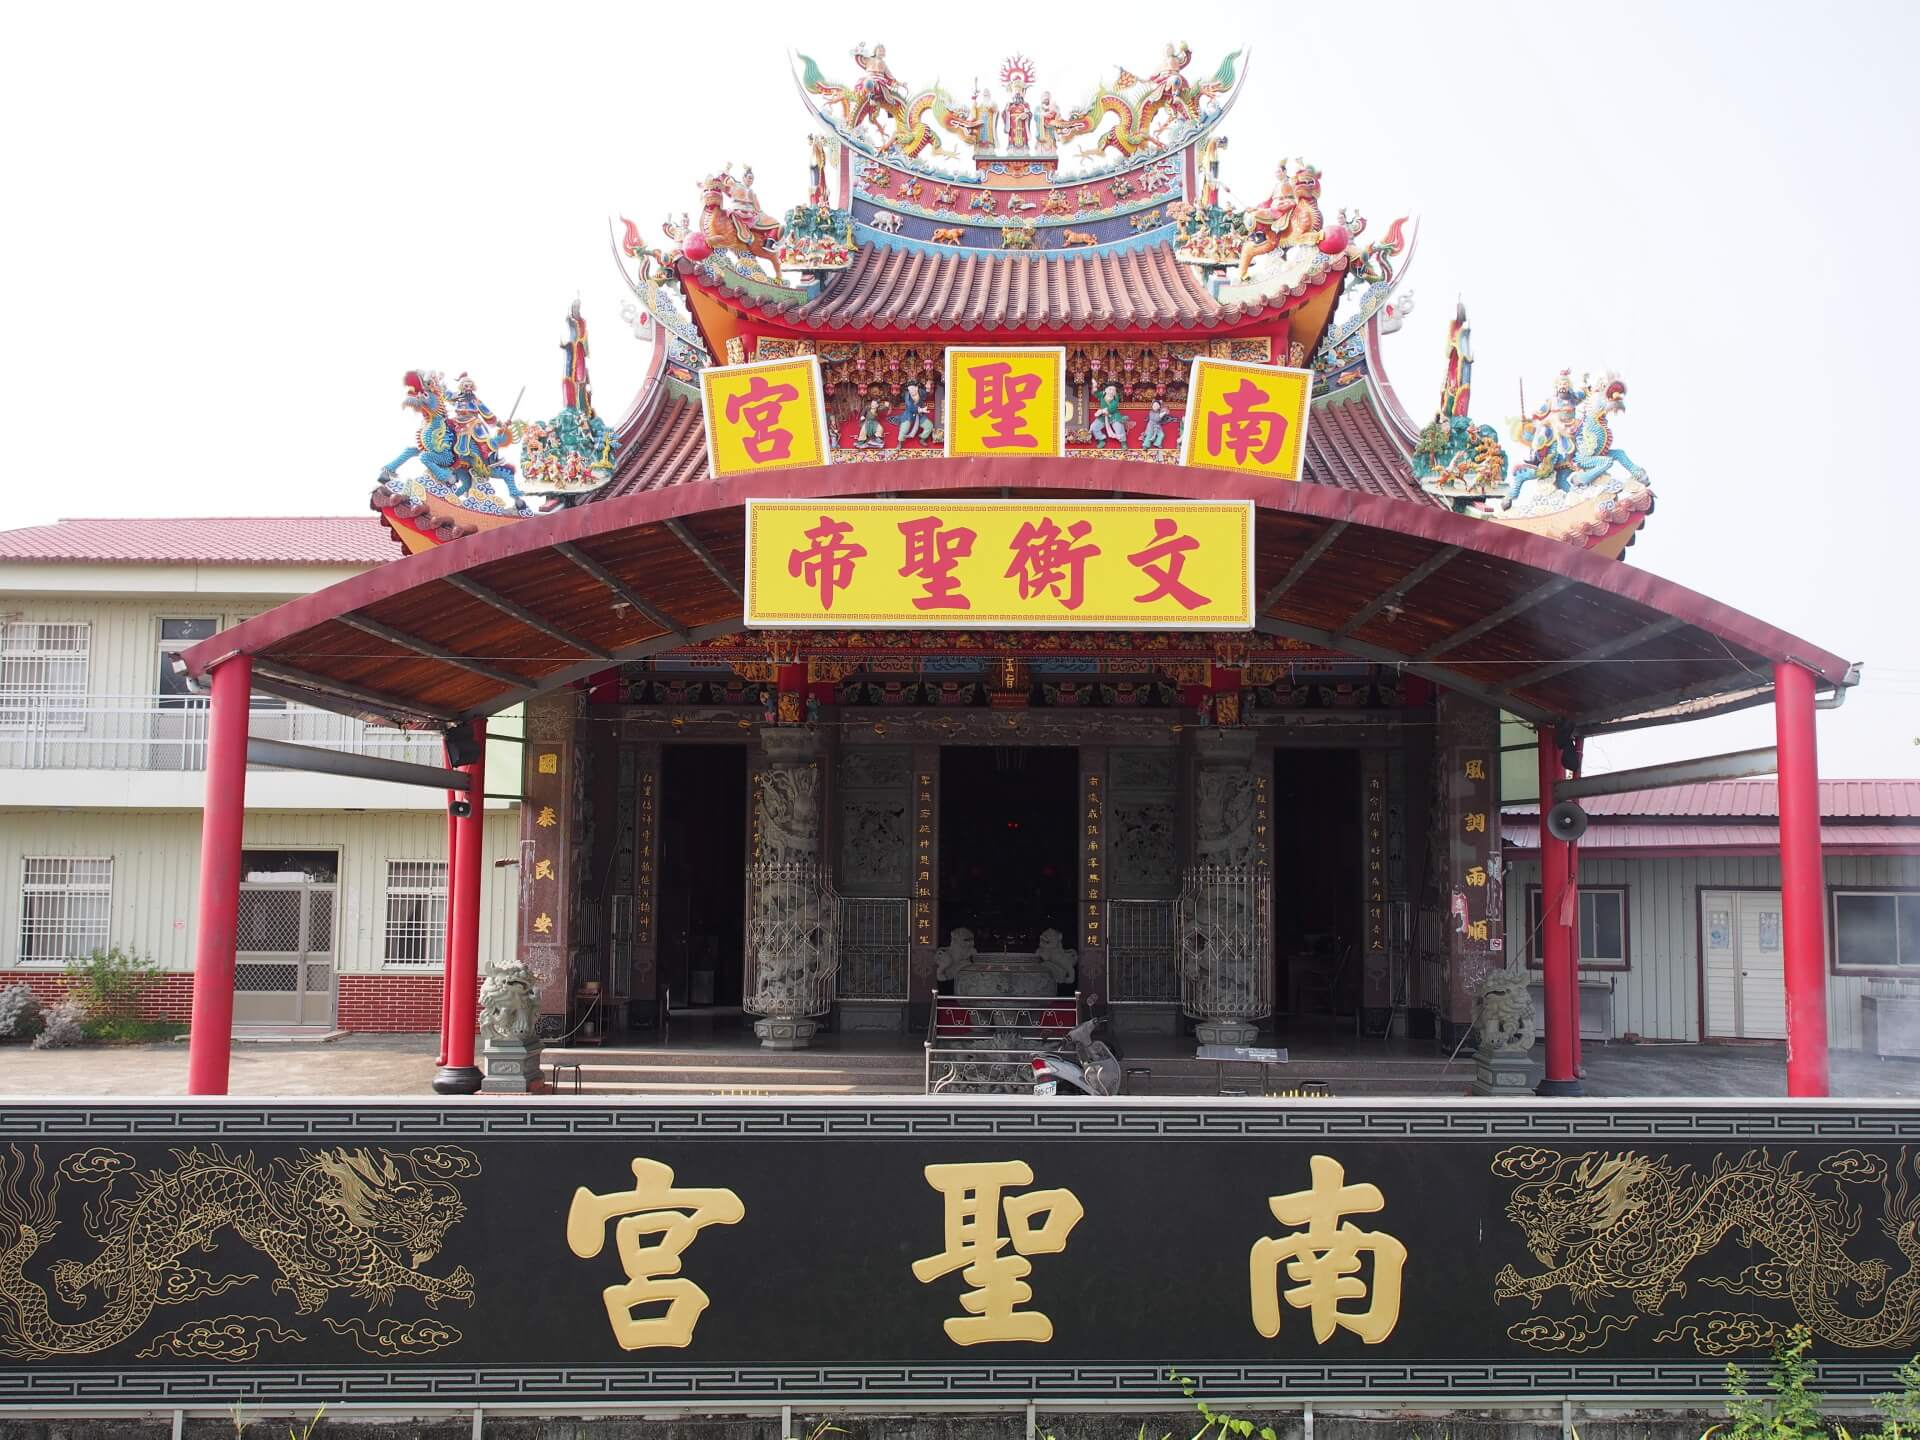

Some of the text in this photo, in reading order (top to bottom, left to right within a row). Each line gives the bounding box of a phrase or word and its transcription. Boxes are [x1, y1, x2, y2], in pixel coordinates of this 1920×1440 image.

[726, 362, 1288, 465] 南聖宮
[788, 516, 1212, 610] 文衡聖帝
[1005, 658, 1015, 689] 玉旨
[533, 753, 557, 934] 國泰民安
[1464, 760, 1488, 942] 風調雨順
[567, 1157, 1407, 1350] 南聖宮
